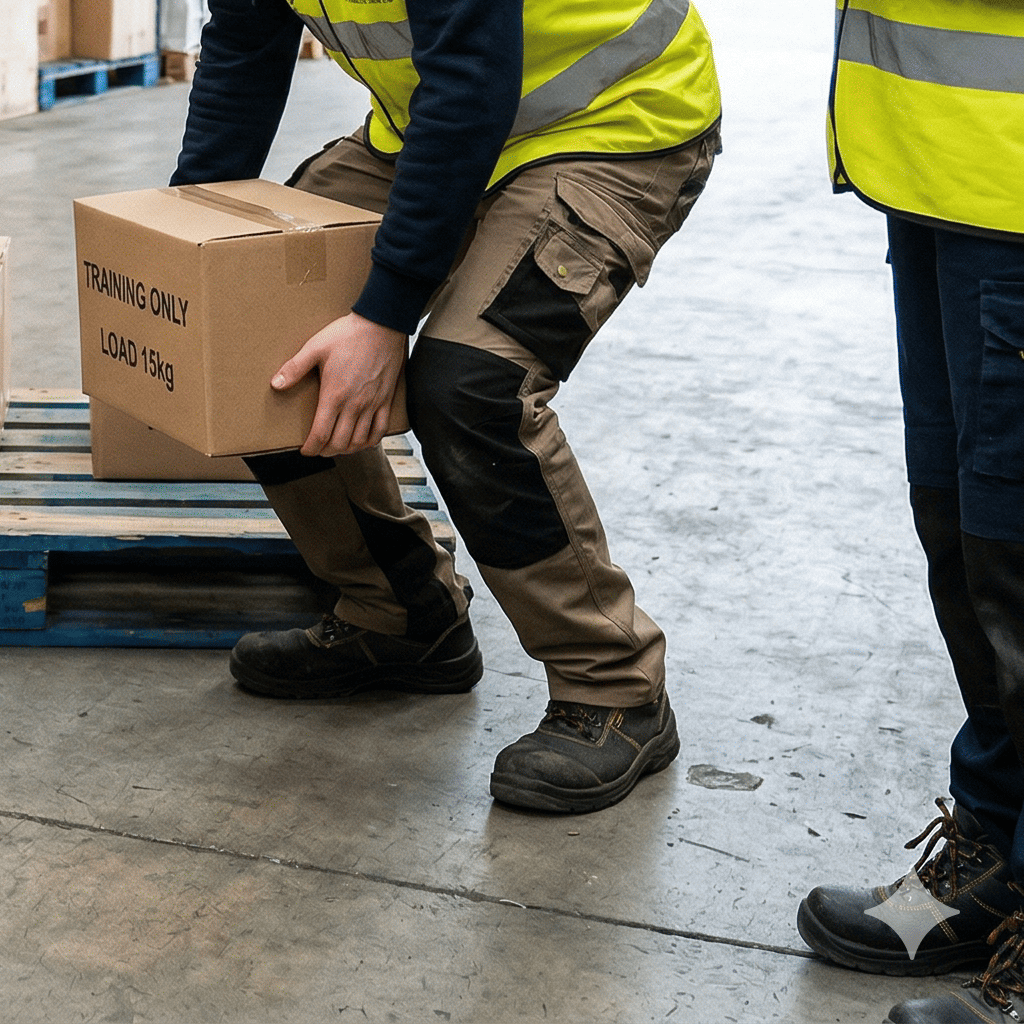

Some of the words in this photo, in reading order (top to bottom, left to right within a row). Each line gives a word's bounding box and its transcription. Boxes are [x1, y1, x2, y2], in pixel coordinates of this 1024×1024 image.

[83, 260, 146, 310] TRAINING
[150, 287, 189, 328] ONLY
[100, 327, 137, 367] LOAD
[141, 346, 174, 392] 15kg
